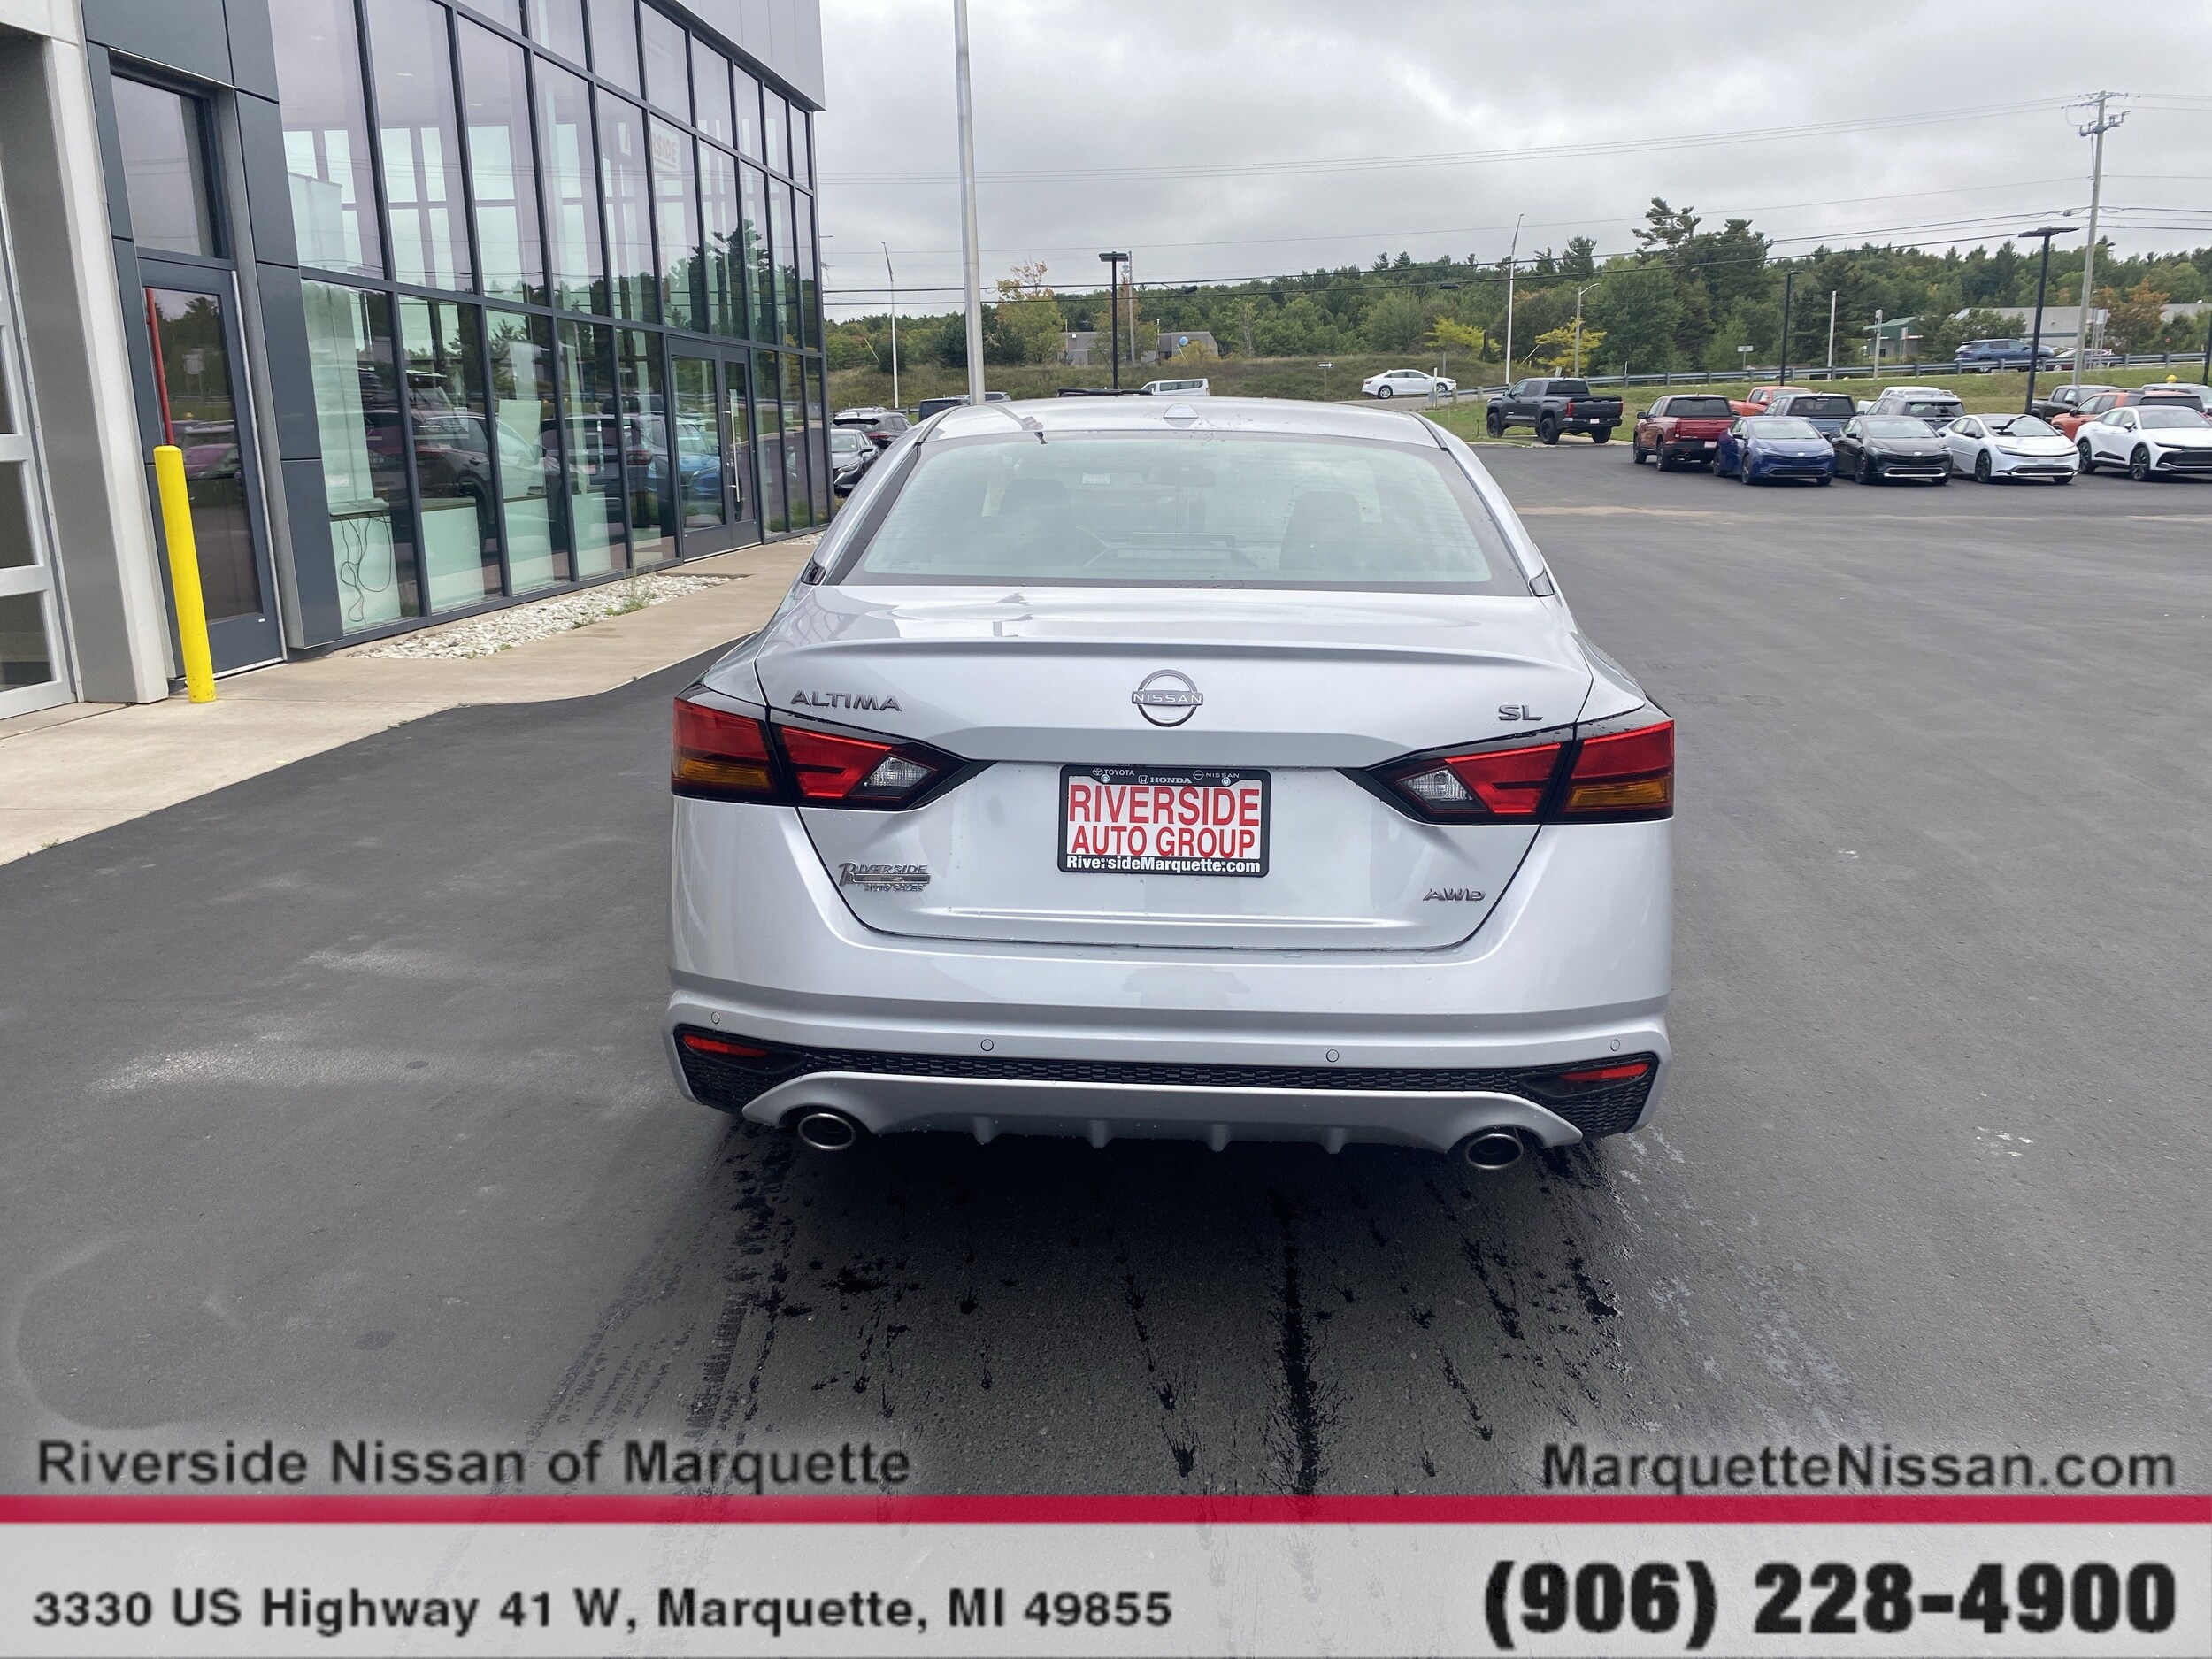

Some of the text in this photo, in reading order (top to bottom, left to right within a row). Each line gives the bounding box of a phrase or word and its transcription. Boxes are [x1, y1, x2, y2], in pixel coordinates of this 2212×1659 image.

[790, 689, 902, 712] ALTIMA
[1133, 693, 1202, 704] NISSAN
[1498, 704, 1543, 721] SL
[1103, 768, 1135, 777] TOYOTA
[1149, 776, 1193, 785] HONDA
[1069, 784, 1260, 826] RIVERSIDE
[1071, 825, 1256, 859] AUTO GROUP
[838, 861, 929, 886] RIVERSIDE
[1423, 887, 1486, 902] AWD
